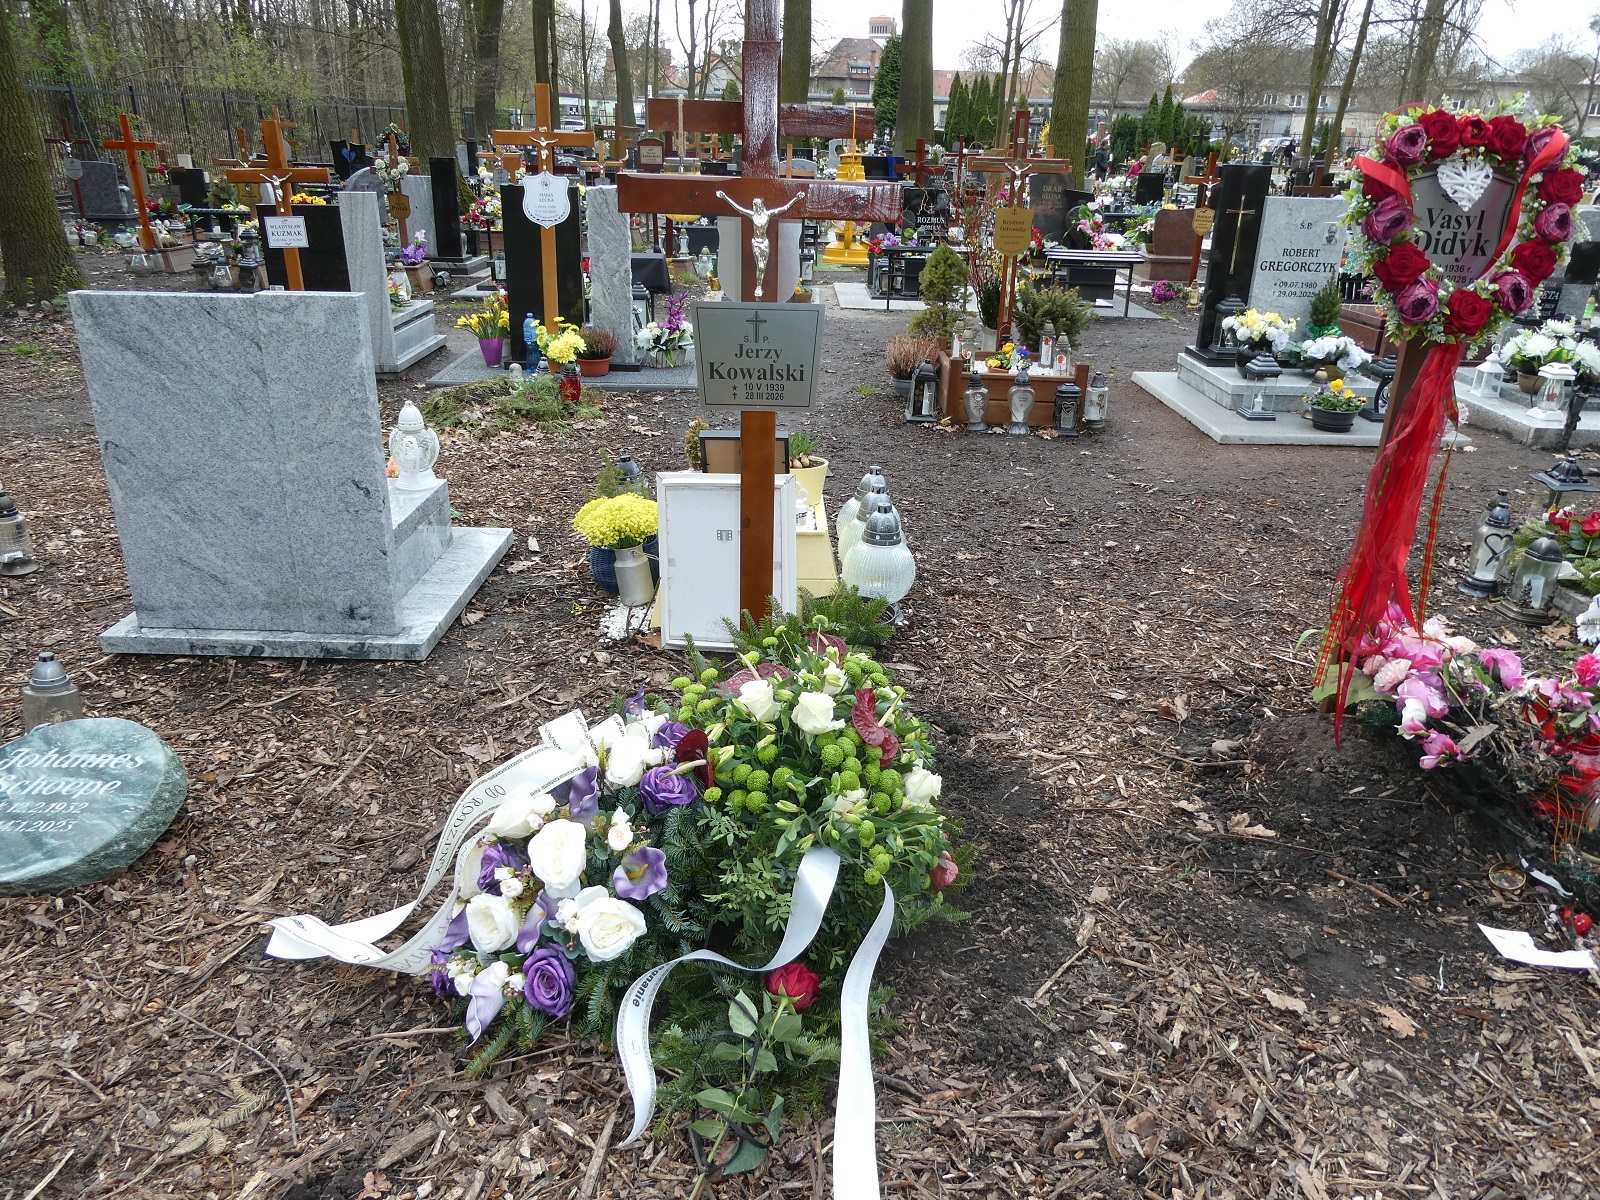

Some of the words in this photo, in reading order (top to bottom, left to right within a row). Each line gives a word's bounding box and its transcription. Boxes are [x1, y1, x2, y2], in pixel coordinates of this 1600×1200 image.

[1426, 208, 1486, 236] Vasyl
[1282, 248, 1321, 258] ROBERT
[1413, 230, 1491, 262] Didyk
[1260, 261, 1337, 273] GREGORCZYK
[1444, 264, 1465, 272] 1936
[734, 343, 783, 363] Jerzy
[708, 361, 805, 382] Kowalski
[744, 383, 754, 391] 10
[755, 383, 763, 391] V
[766, 384, 785, 392] 1939
[745, 392, 754, 400] 28
[756, 392, 764, 400] III
[766, 393, 785, 401] 2026
[0, 747, 144, 770] Johannes
[0, 774, 122, 799] Schoepe
[435, 797, 484, 876] RODZINY
